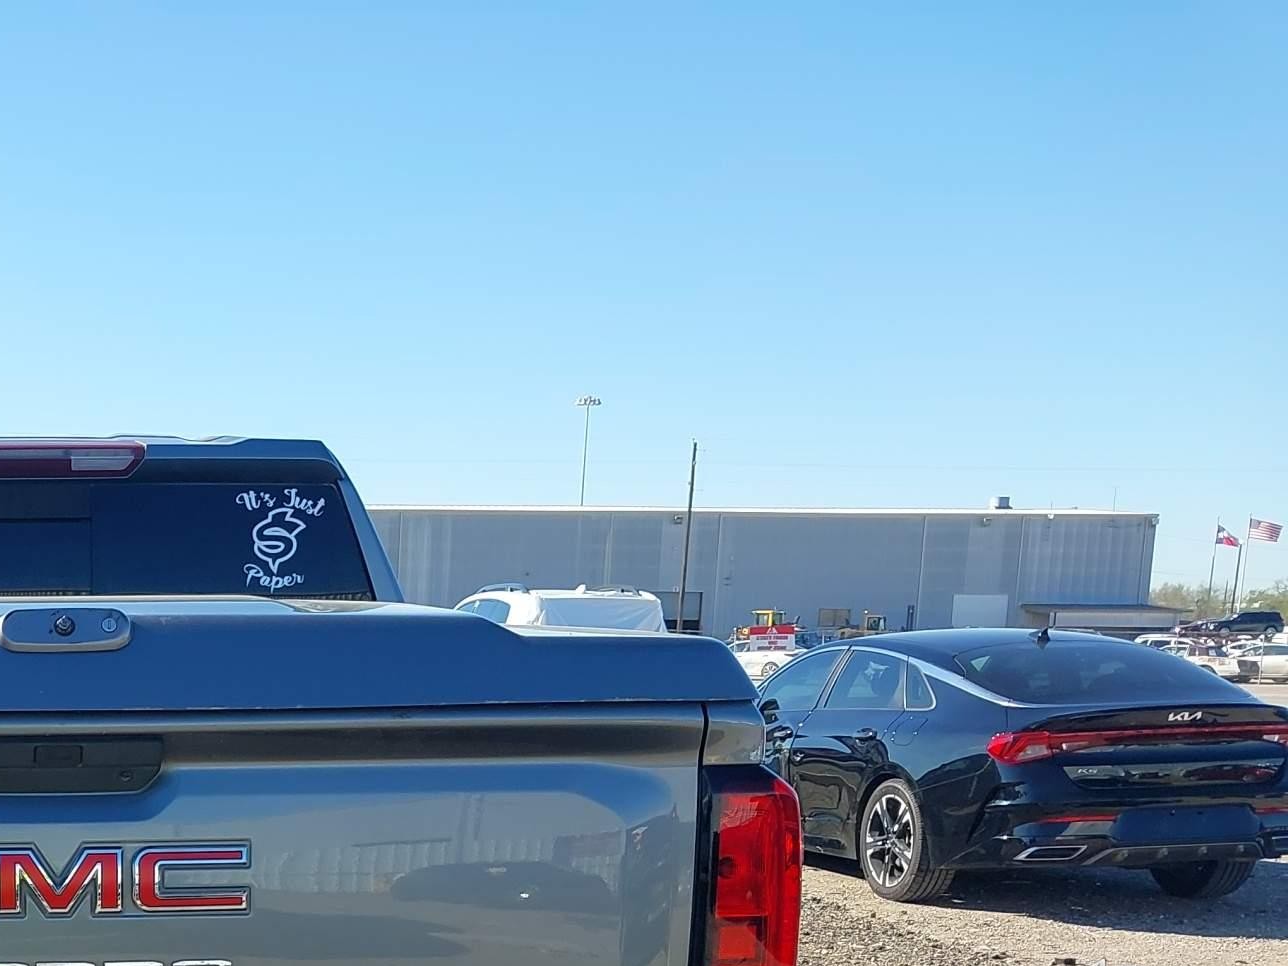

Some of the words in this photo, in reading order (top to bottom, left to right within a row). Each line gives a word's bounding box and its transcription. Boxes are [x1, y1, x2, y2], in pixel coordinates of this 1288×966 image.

[235, 490, 277, 511] It's
[283, 488, 326, 517] Just
[243, 563, 305, 594] Paper
[1168, 711, 1202, 721] KIA
